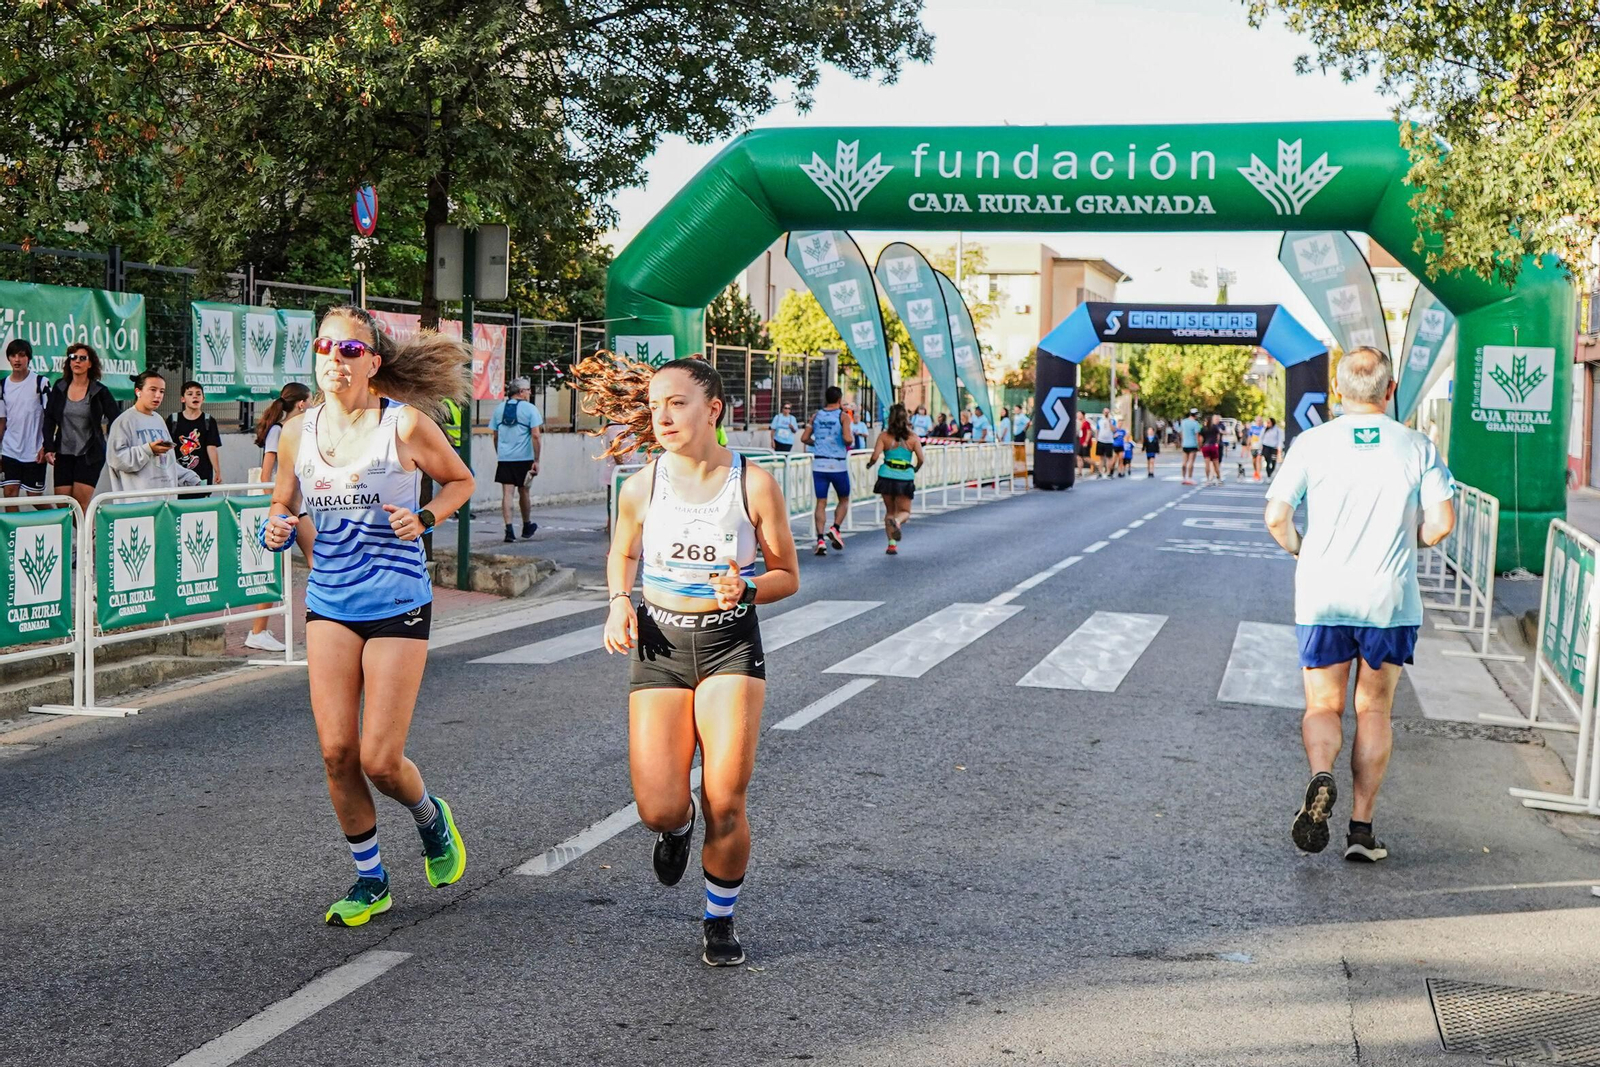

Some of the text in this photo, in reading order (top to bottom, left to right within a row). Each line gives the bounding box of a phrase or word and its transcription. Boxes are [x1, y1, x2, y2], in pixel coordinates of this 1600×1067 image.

[911, 143, 1216, 180] fundación
[908, 193, 1216, 214] CAJA RURAL GRANADA
[1130, 313, 1255, 328] CAMISETAS
[16, 309, 138, 351] fundación
[28, 355, 50, 373] AJA
[100, 358, 139, 376] ANADA
[196, 373, 212, 385] CAJA
[1472, 347, 1483, 408] fundación
[1471, 409, 1551, 425] CAJA RURAL
[1485, 423, 1535, 434] GRANADA
[307, 493, 381, 507] MARACENA
[671, 542, 717, 562] 268
[7, 531, 16, 607] fundación
[177, 580, 218, 597] CAJA RURAL
[237, 573, 275, 588] CAJA RURAL
[109, 589, 155, 608] CAJA RURAL
[246, 586, 268, 596] GRANADA
[185, 594, 210, 606] GRANADA
[8, 603, 61, 623] CAJA RURAL
[118, 604, 147, 617] GRANADA
[647, 605, 748, 628] NIKE PRO
[19, 620, 50, 632] GRANADA
